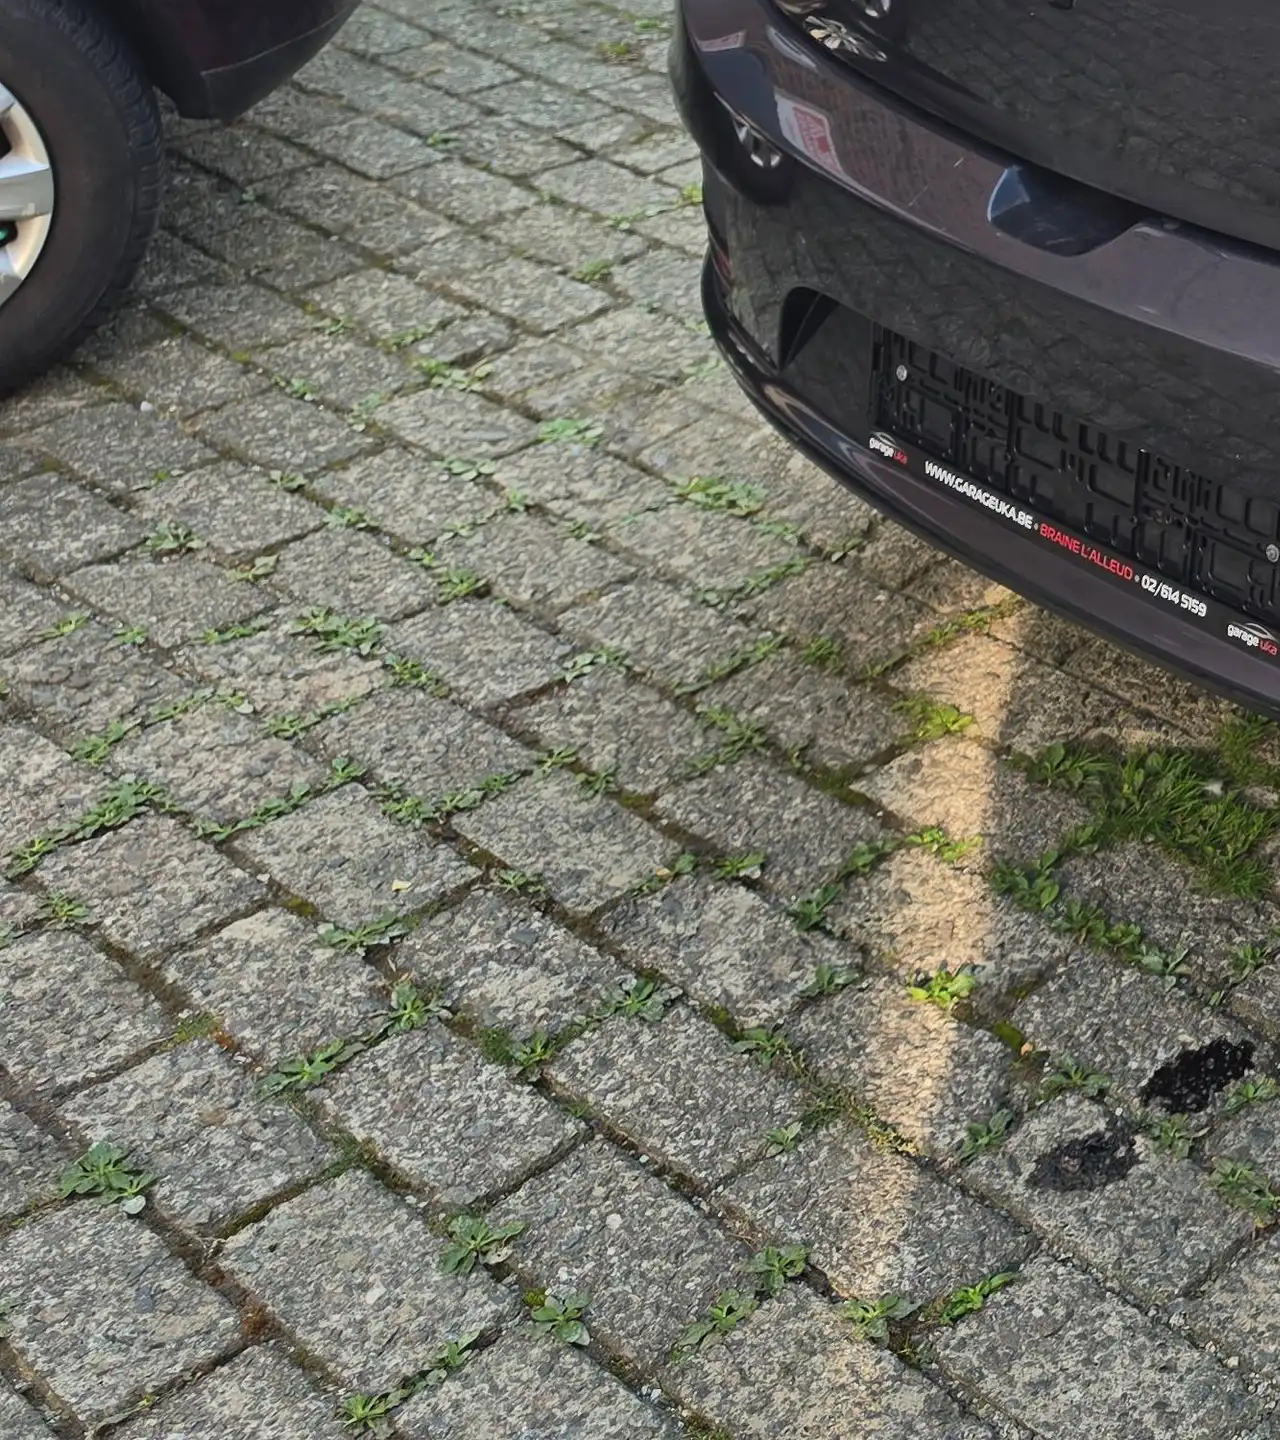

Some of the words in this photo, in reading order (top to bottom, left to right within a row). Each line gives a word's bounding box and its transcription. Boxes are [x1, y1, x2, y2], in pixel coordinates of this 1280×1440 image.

[924, 460, 1034, 530] WWW.GARAGEUKA.BE
[1039, 522, 1081, 555] BRAINE
[1140, 574, 1180, 605] 02/614
[1180, 593, 1208, 618] 5159
[1227, 623, 1260, 648] garage
[1258, 638, 1278, 657] uka
